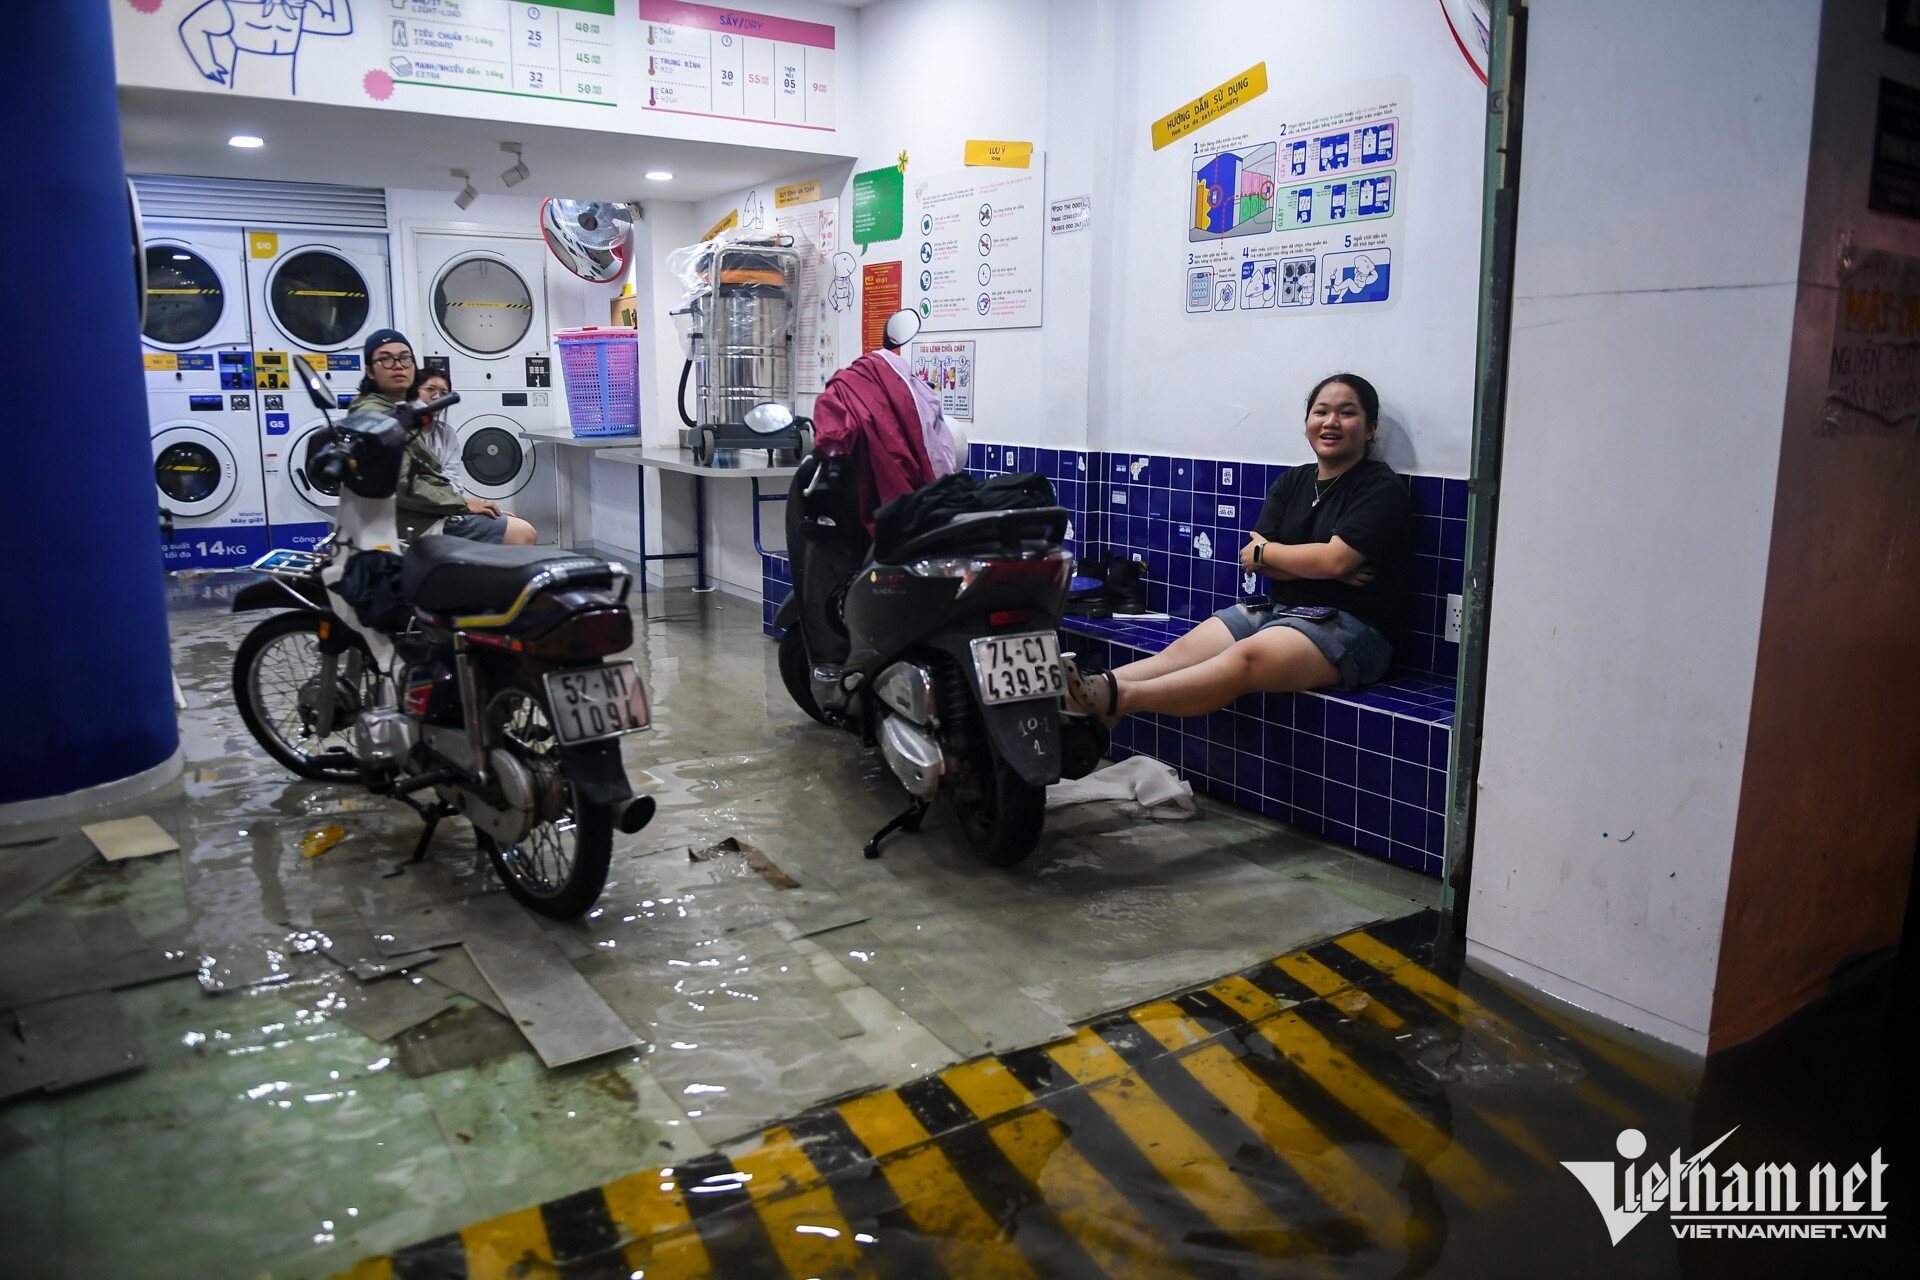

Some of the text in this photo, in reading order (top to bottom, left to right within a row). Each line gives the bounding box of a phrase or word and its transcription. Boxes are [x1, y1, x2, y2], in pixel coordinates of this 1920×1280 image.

[720, 12, 764, 29] SẤY/DRY
[414, 28, 434, 38] TIÊU
[576, 23, 590, 32] 40
[528, 30, 542, 41] 25
[414, 38, 454, 49] STANDARD
[576, 54, 590, 63] 45
[660, 58, 701, 69] TRUNG BÌNH
[529, 72, 543, 82] 32
[722, 70, 734, 80] 30
[748, 74, 760, 84] 55
[578, 84, 591, 94] 50
[784, 79, 796, 89] 05
[813, 83, 818, 91] 9
[1167, 78, 1249, 130] HƯỚNG DẪN SỬ DỤNG
[1172, 128, 1180, 136] How
[1202, 97, 1239, 120] self-laundry
[1280, 123, 1287, 136] 2
[1194, 142, 1198, 154] 1
[1345, 235, 1351, 248] 5
[1243, 247, 1249, 258] 4
[1188, 253, 1194, 264] 3
[170, 542, 190, 550] suất
[986, 637, 1048, 670] 74-C1
[987, 664, 1063, 699] 439.56
